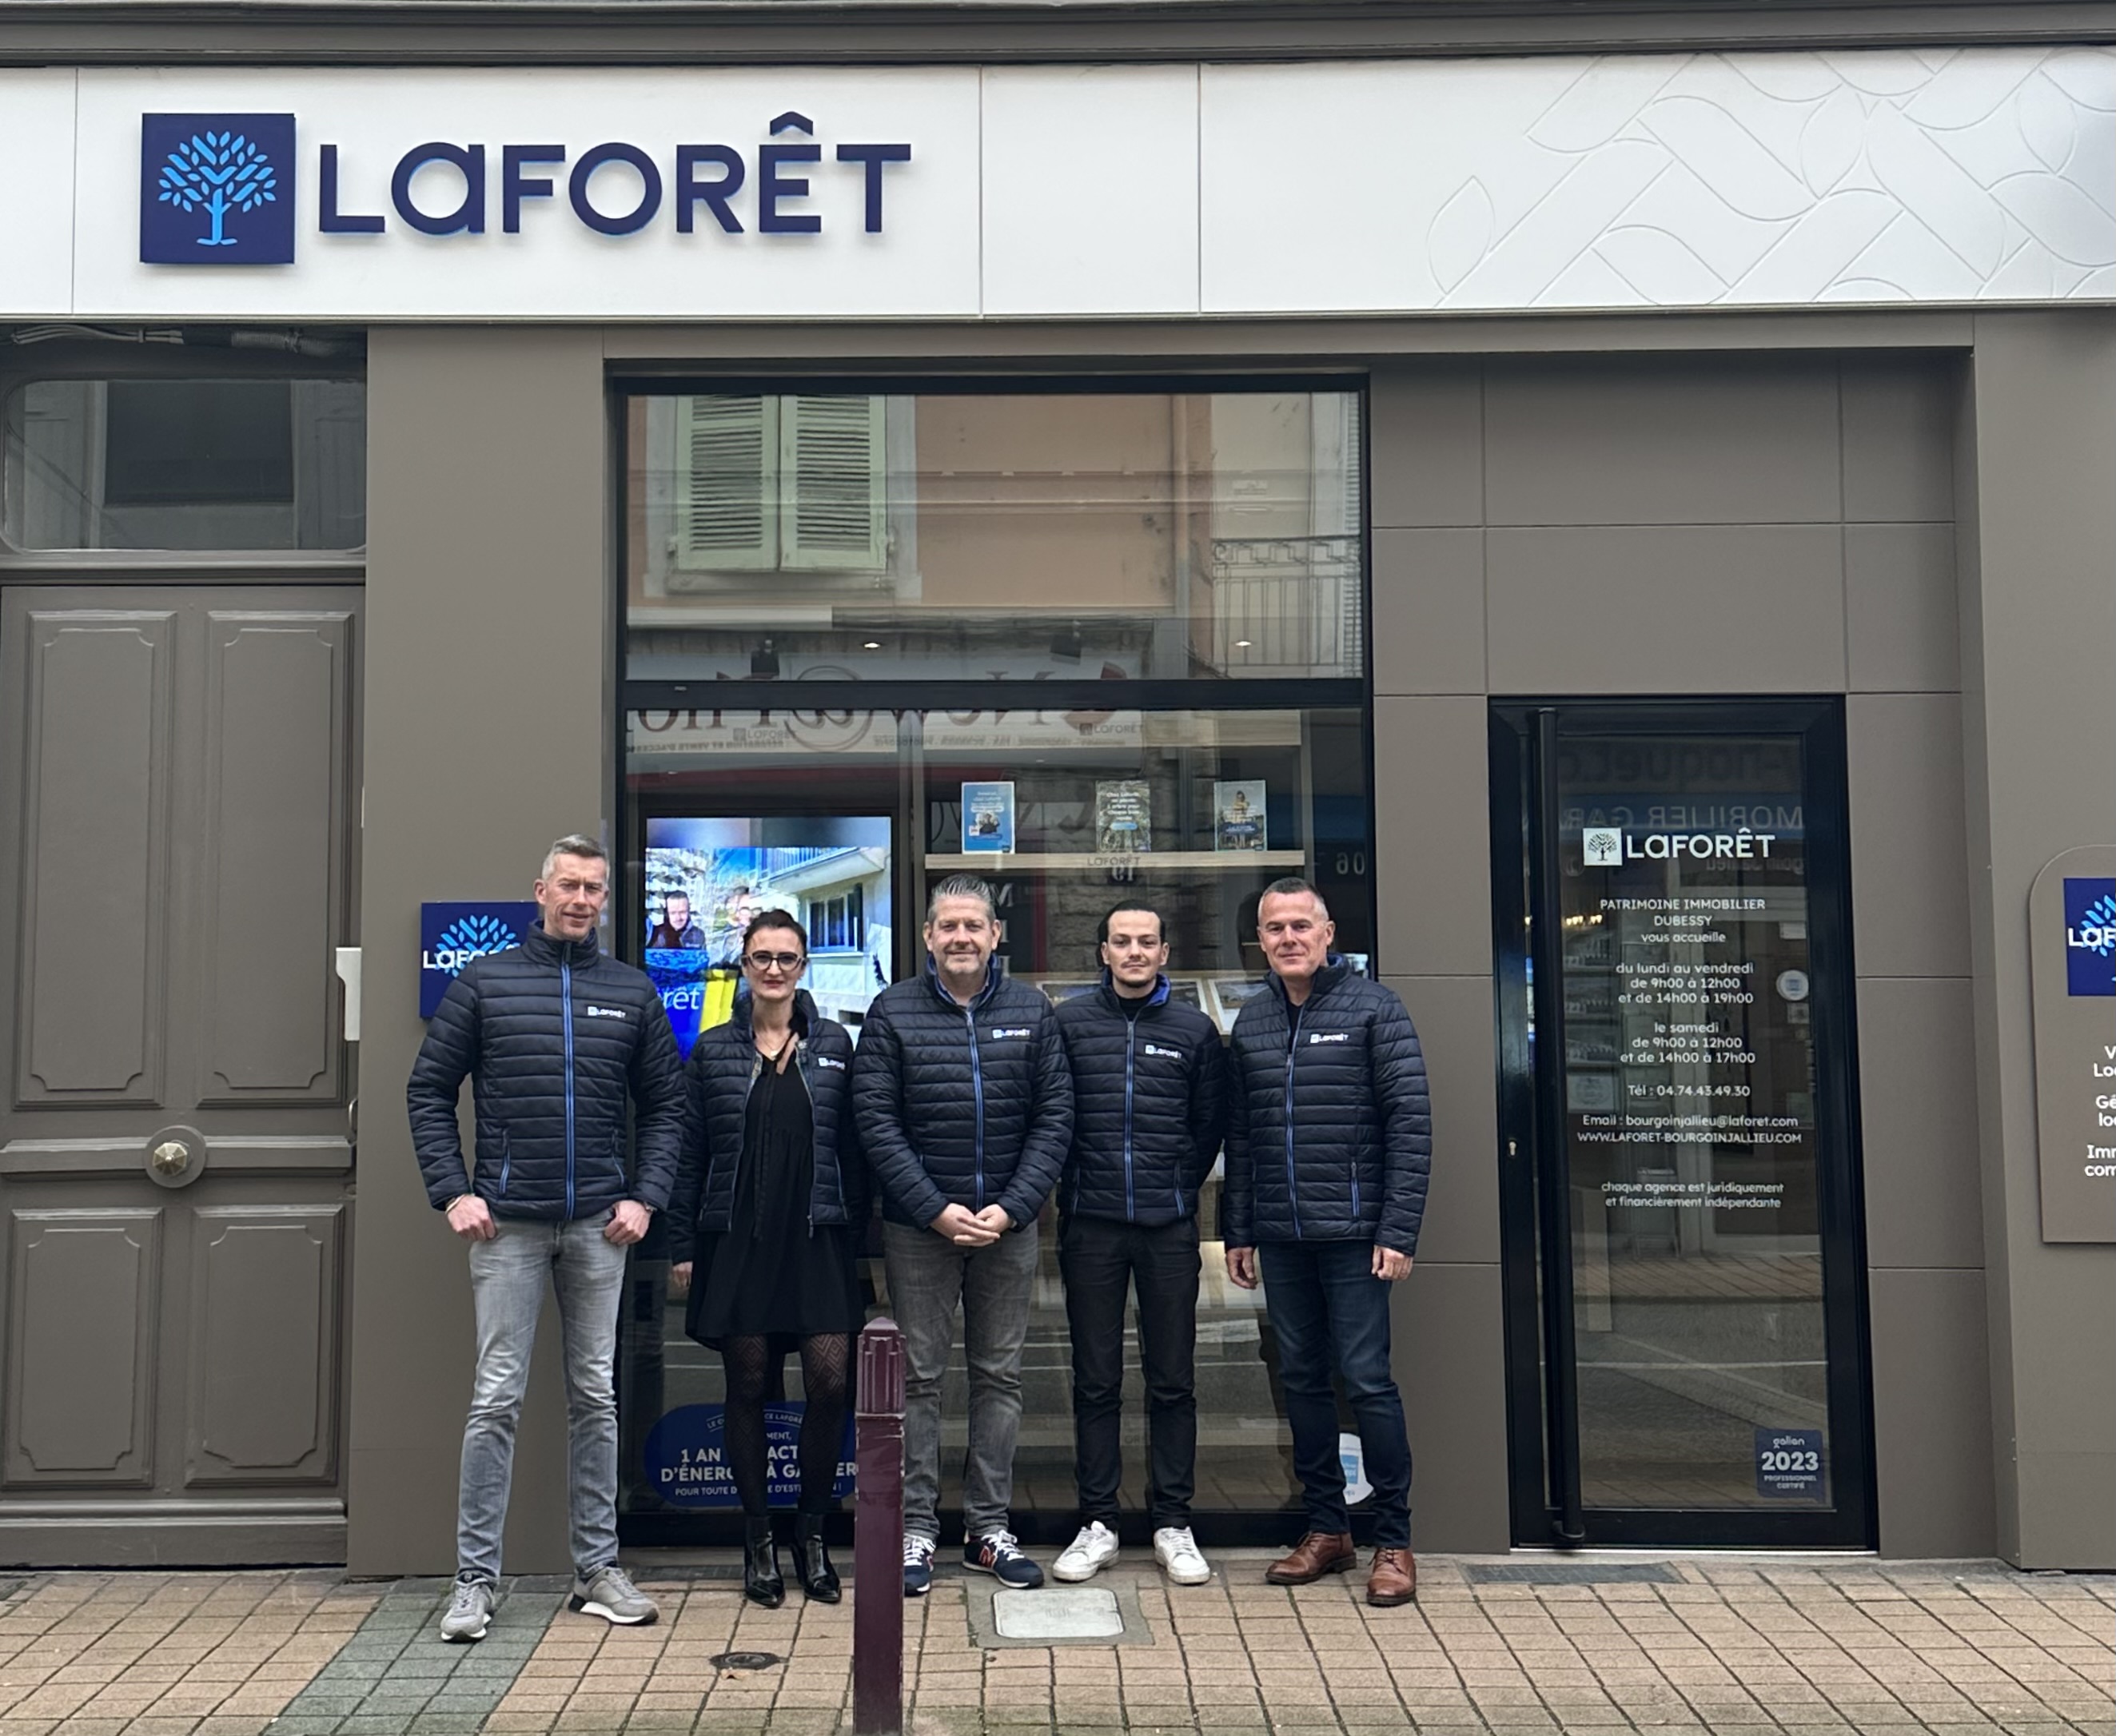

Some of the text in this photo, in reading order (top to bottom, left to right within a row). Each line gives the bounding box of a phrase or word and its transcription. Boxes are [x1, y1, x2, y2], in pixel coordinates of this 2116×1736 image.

[1600, 899, 1766, 910] PATRIMOINE IMMOBILIER
[1654, 915, 1712, 926] DUBESSY
[1641, 932, 1727, 943] vous accueille
[1616, 962, 1754, 974] du lundi au vendredi
[1630, 977, 1740, 989] de 9h00 à 12h00
[657, 986, 701, 1010] rêt
[1618, 993, 1632, 1004] et
[1636, 993, 1653, 1004] de
[1656, 993, 1697, 1004] 14h00
[1714, 993, 1754, 1004] 19h00
[1654, 1022, 1719, 1033] le samedi
[1632, 1037, 1649, 1049] de
[1652, 1037, 1686, 1049] 9h00
[1704, 1037, 1743, 1049] 12h00
[1620, 1052, 1633, 1064] et
[1637, 1052, 1655, 1064] de
[1659, 1052, 1700, 1064] 14h00
[1716, 1052, 1756, 1064] 17h00
[2093, 1062, 2116, 1077] Lo
[1628, 1085, 1647, 1096] Tél
[1657, 1085, 1751, 1097] 04.74.43.49.30
[1583, 1115, 1616, 1126] Email
[1626, 1113, 1799, 1129] bourgoinjallieu@laforet.com
[2098, 1112, 2116, 1127] lo
[1577, 1132, 1802, 1144] WWW.LAFORET-BOURGOINJALLIEU.COM
[1601, 1181, 1784, 1194] chaque agence est juridiquement
[1605, 1196, 1781, 1210] et financièrement indépendante
[681, 1447, 721, 1463] 1 AN
[1760, 1451, 1819, 1471] 2023
[675, 1487, 699, 1497] POUR
[701, 1486, 729, 1496] TOUTE
